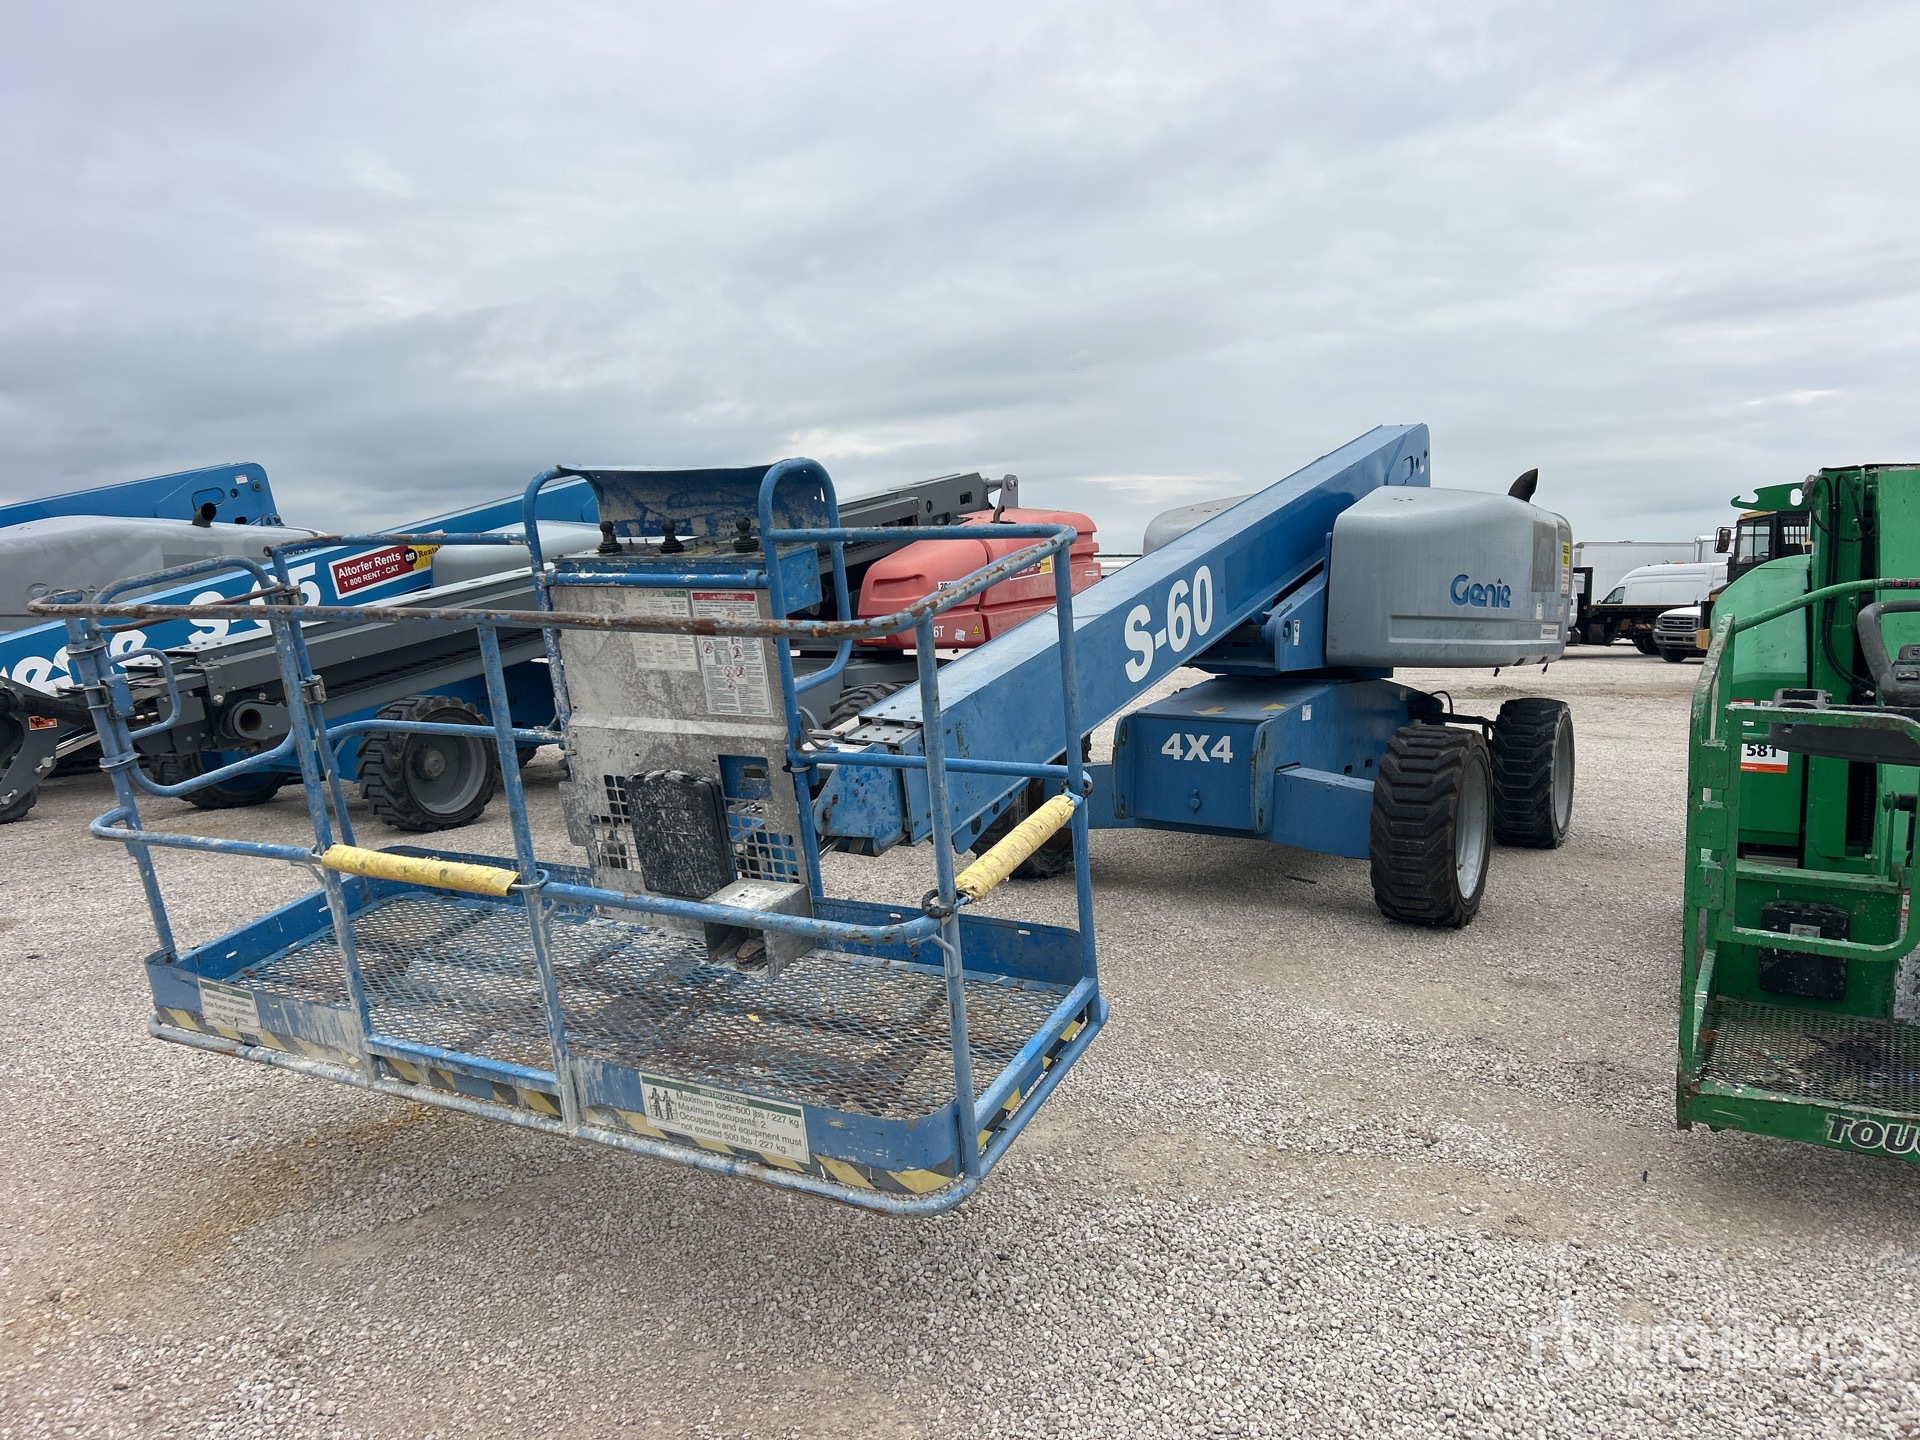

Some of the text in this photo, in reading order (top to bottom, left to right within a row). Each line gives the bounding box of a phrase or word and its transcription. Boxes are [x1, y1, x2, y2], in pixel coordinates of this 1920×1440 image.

[338, 552, 401, 578] Altorfer Rents
[405, 552, 415, 561] CAT
[350, 577, 362, 586] 800
[363, 570, 380, 581] RENT
[386, 564, 399, 574] CAT
[1450, 574, 1511, 608] Genie
[1124, 565, 1213, 683] S-60
[1161, 733, 1233, 763] 4X4
[1746, 744, 1777, 757] 581
[676, 1090, 713, 1108] Maximum
[736, 1106, 751, 1116] 500
[753, 1108, 765, 1119] lbs
[771, 1113, 787, 1124] 227
[789, 1117, 802, 1129] kg.
[677, 1101, 716, 1117] Maximum
[699, 1089, 749, 1105] INSTRUCTIONS
[679, 1111, 803, 1147] Occupants and equipment must
[681, 1123, 693, 1132] not
[695, 1126, 722, 1138] exceed
[724, 1131, 739, 1142] 500
[740, 1135, 753, 1145] lbs
[759, 1140, 774, 1150] 227
[1825, 1112, 1920, 1155] TOU
